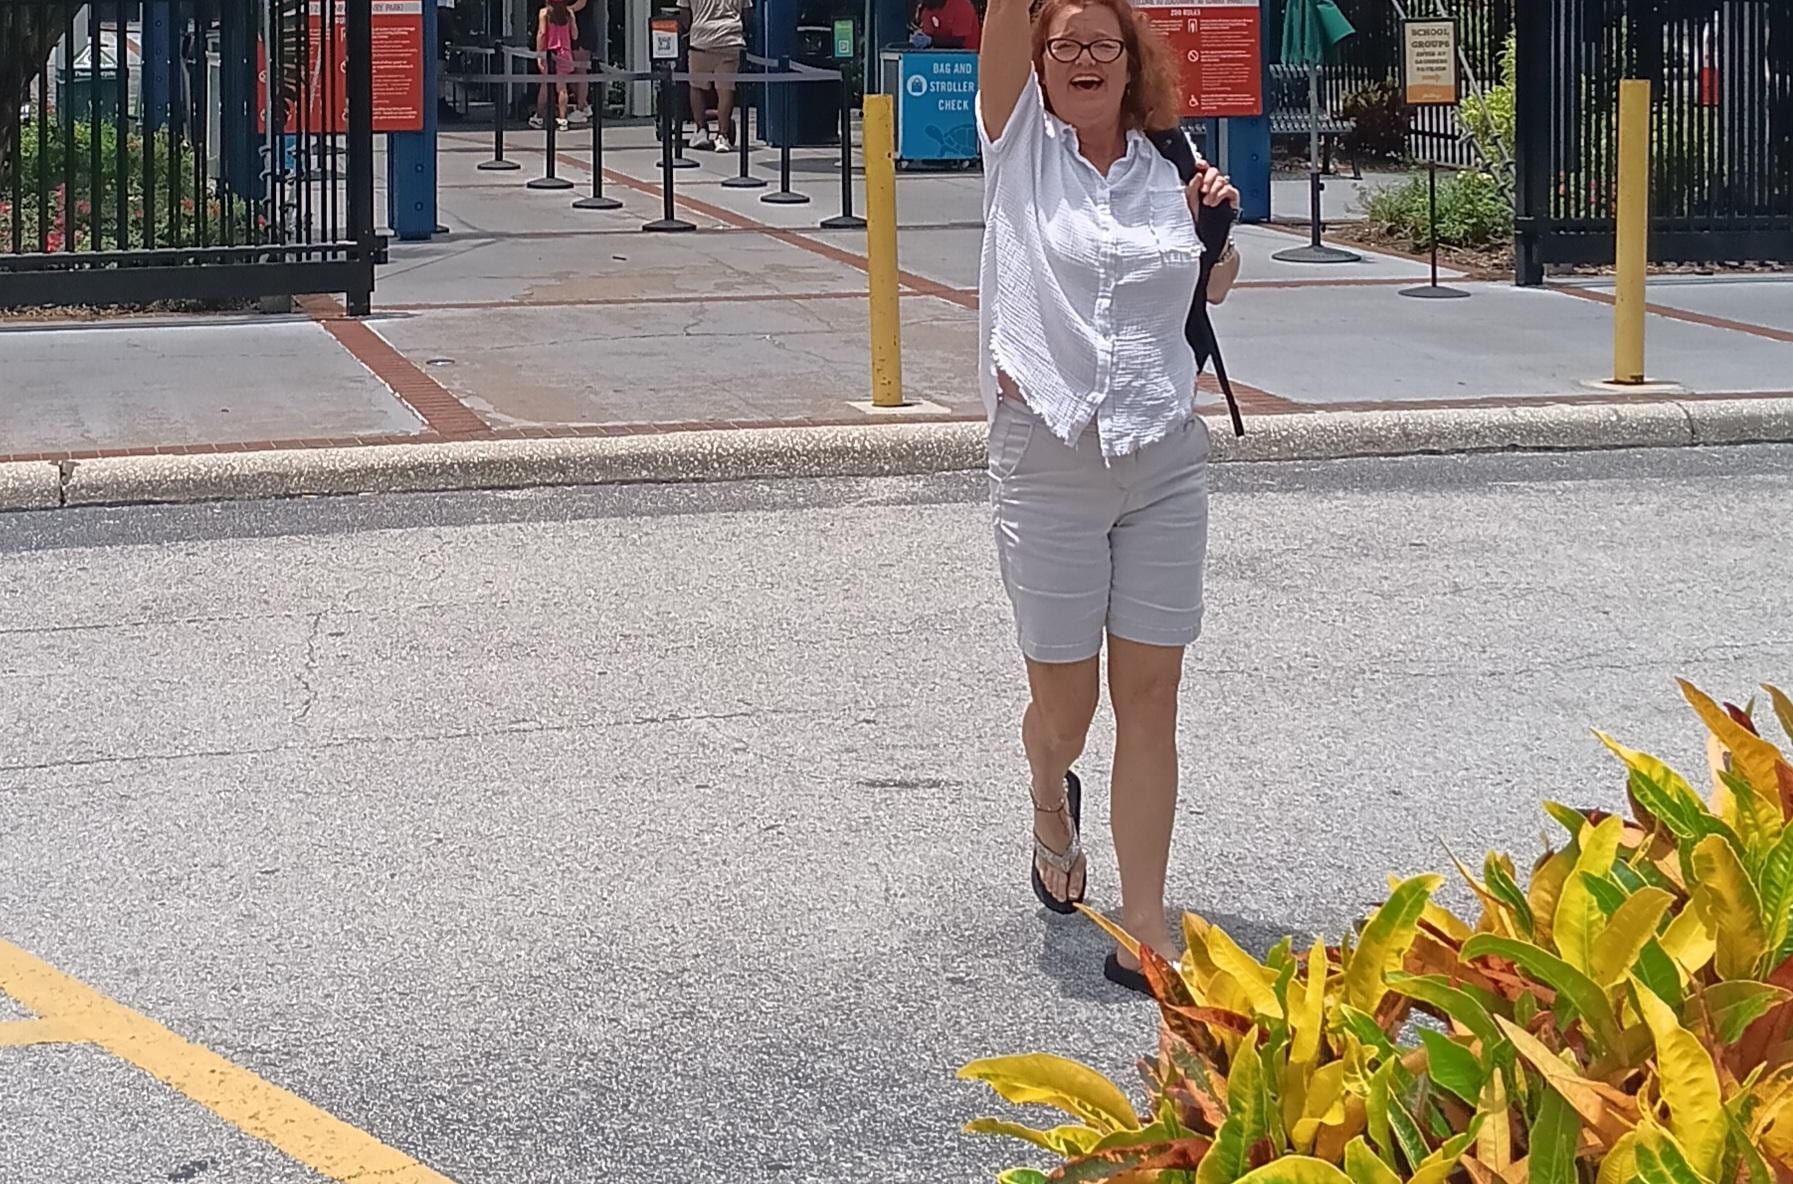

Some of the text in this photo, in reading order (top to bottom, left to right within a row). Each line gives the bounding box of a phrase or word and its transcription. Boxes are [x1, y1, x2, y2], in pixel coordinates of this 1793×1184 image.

[1411, 28, 1450, 36] SCHOOL
[1411, 40, 1450, 48] GROUPS
[933, 63, 972, 74] BAG AND
[929, 81, 975, 93] STROLLER
[938, 99, 969, 111] CHECK
